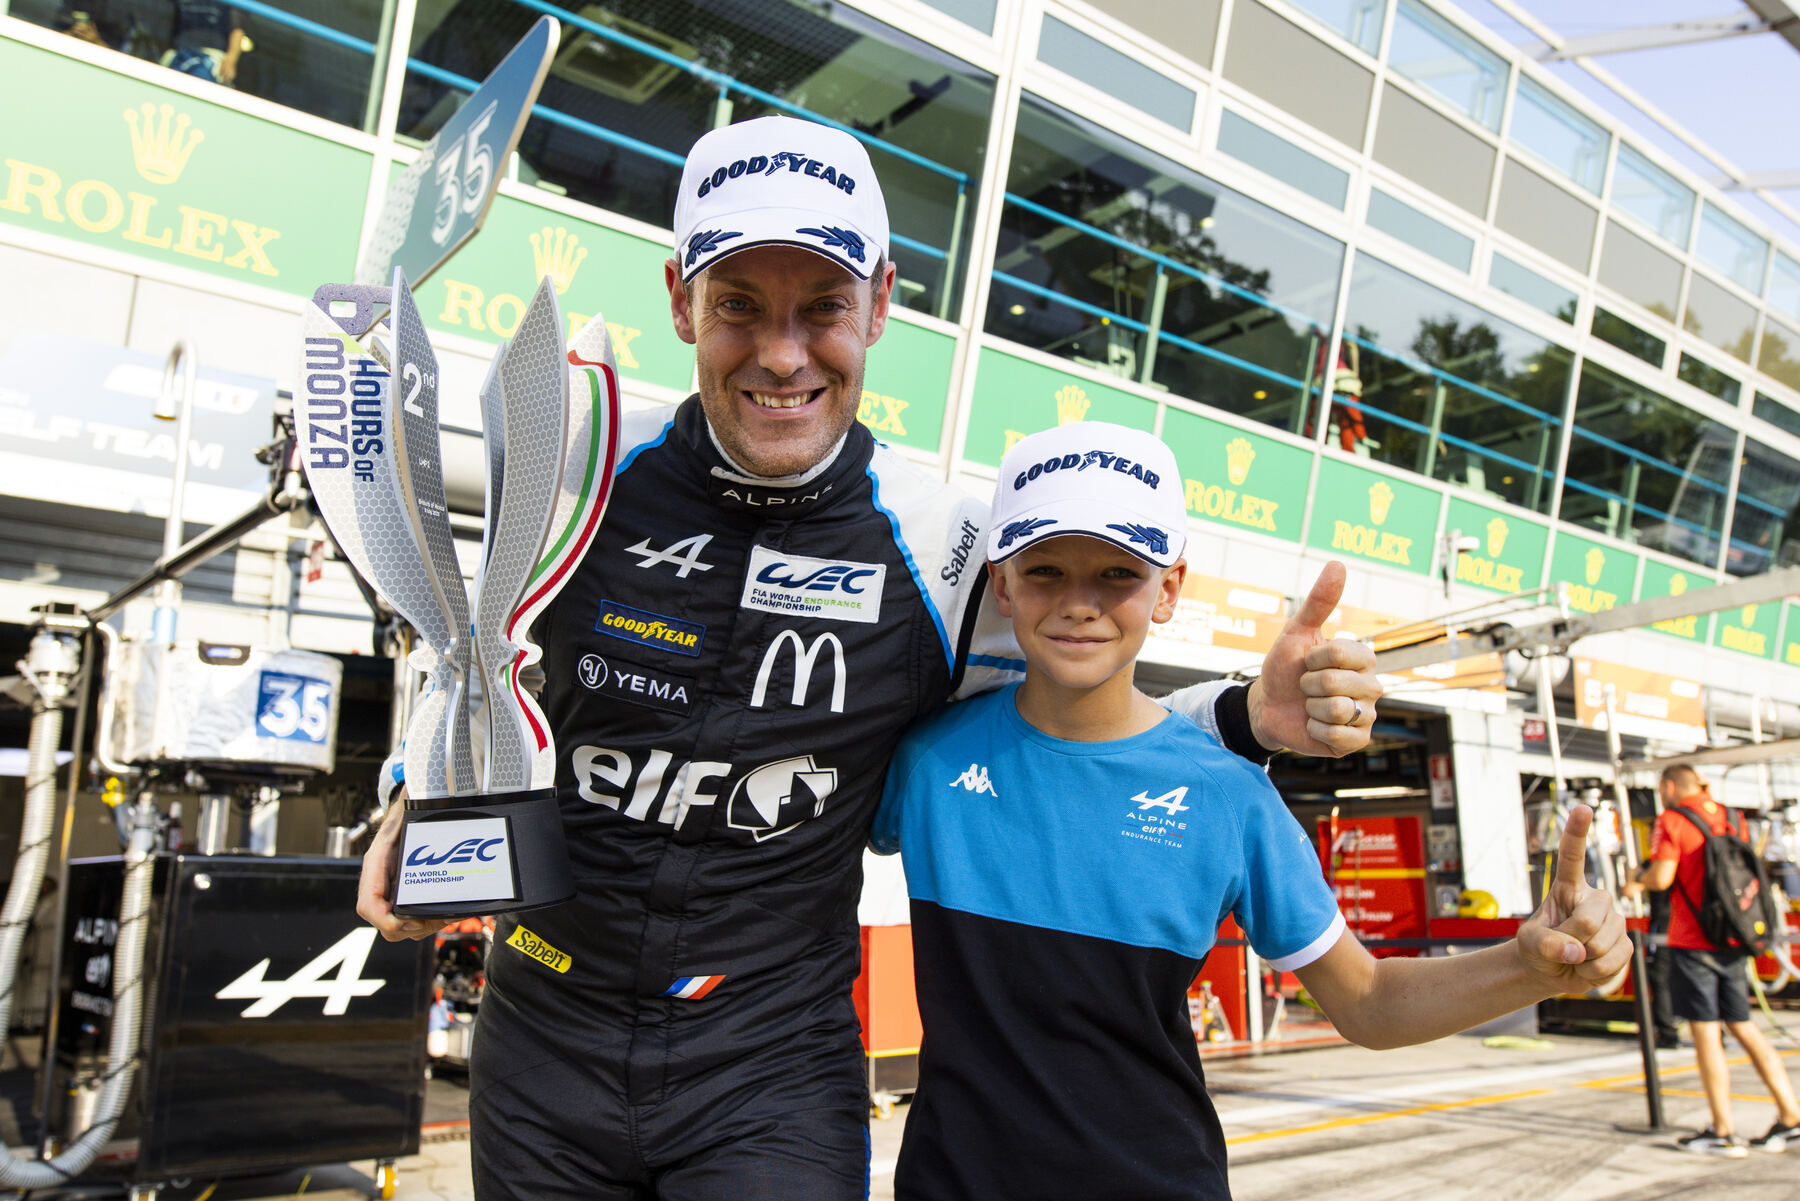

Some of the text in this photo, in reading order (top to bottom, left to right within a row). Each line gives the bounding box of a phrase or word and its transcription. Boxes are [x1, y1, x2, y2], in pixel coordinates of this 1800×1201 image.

[431, 99, 498, 247] 35
[1, 158, 281, 277] ROLEX
[354, 459, 374, 482] OF
[1184, 478, 1279, 532] ROLEX
[941, 519, 979, 587] Sabelt
[1331, 520, 1413, 566] ROLEX
[755, 562, 878, 595] WEC
[750, 596, 822, 613] CHAMPIONSHIP
[752, 588, 862, 610] FIA WORLD ENDURANCE
[614, 669, 689, 704] YEMA
[259, 674, 332, 742] 35
[571, 744, 733, 832] elf
[1126, 811, 1187, 830] ALPINE
[1142, 825, 1157, 834] elf
[406, 837, 505, 867] WEC
[1121, 830, 1183, 848] ENDURANCE TEAM
[404, 876, 465, 885] CHAMPIONSHIP
[514, 930, 567, 969] Sabelt
